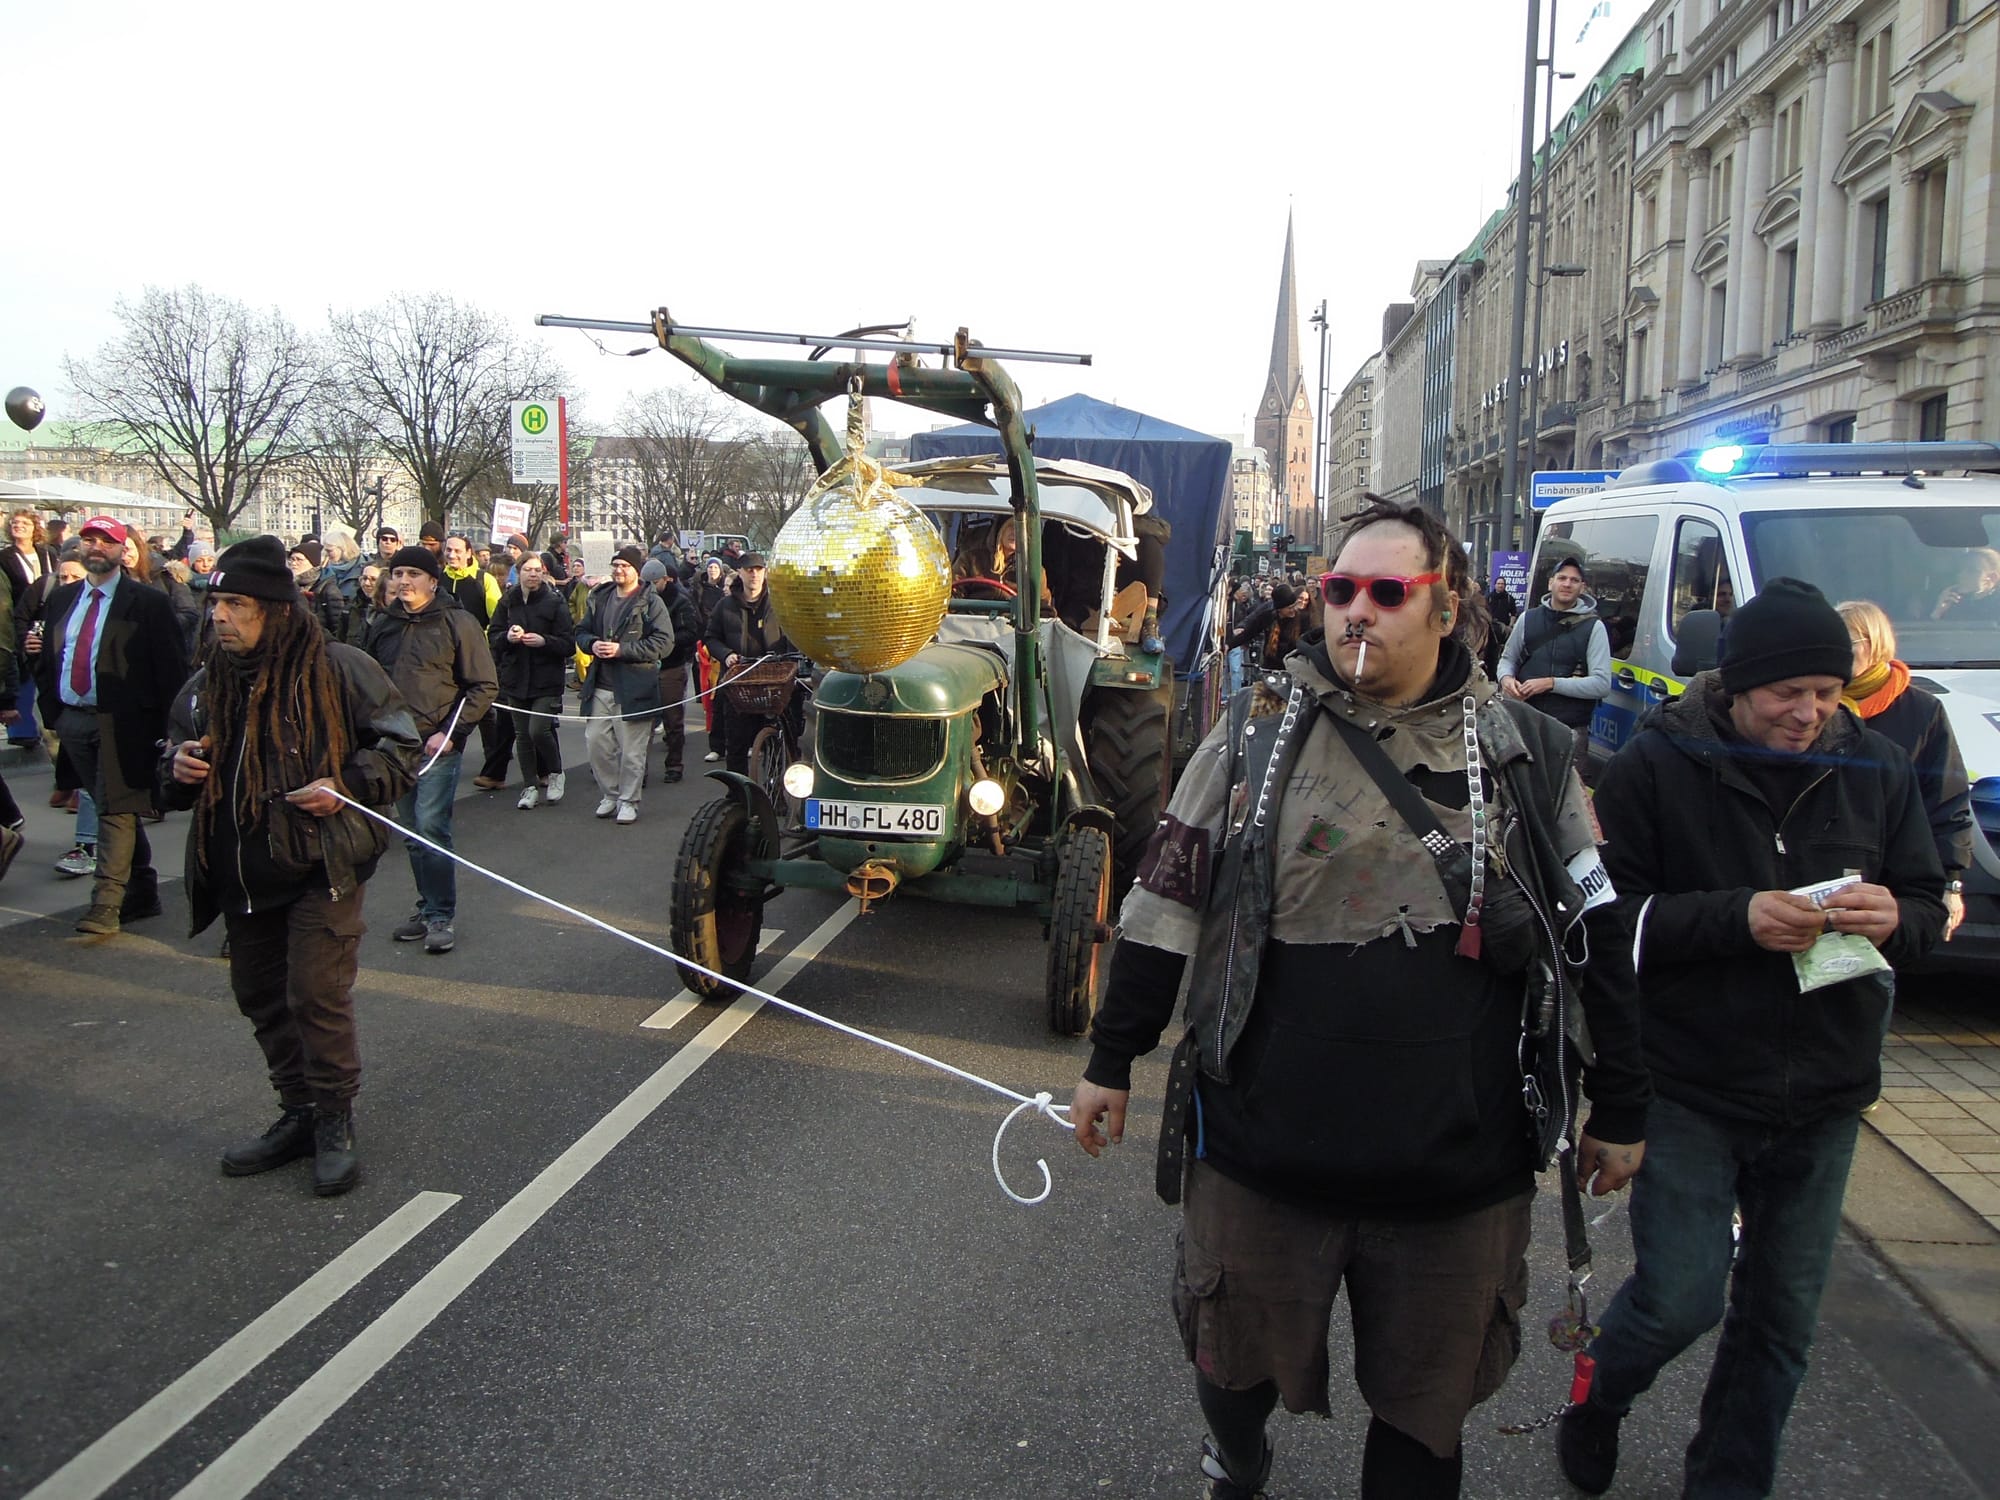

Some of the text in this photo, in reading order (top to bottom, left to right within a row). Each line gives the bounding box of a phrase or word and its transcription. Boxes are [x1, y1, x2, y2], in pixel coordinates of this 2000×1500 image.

[1482, 340, 1567, 410] ALSTAUS
[1538, 486, 1606, 495] Einbahnstraße
[820, 804, 940, 832] HH FL 480
